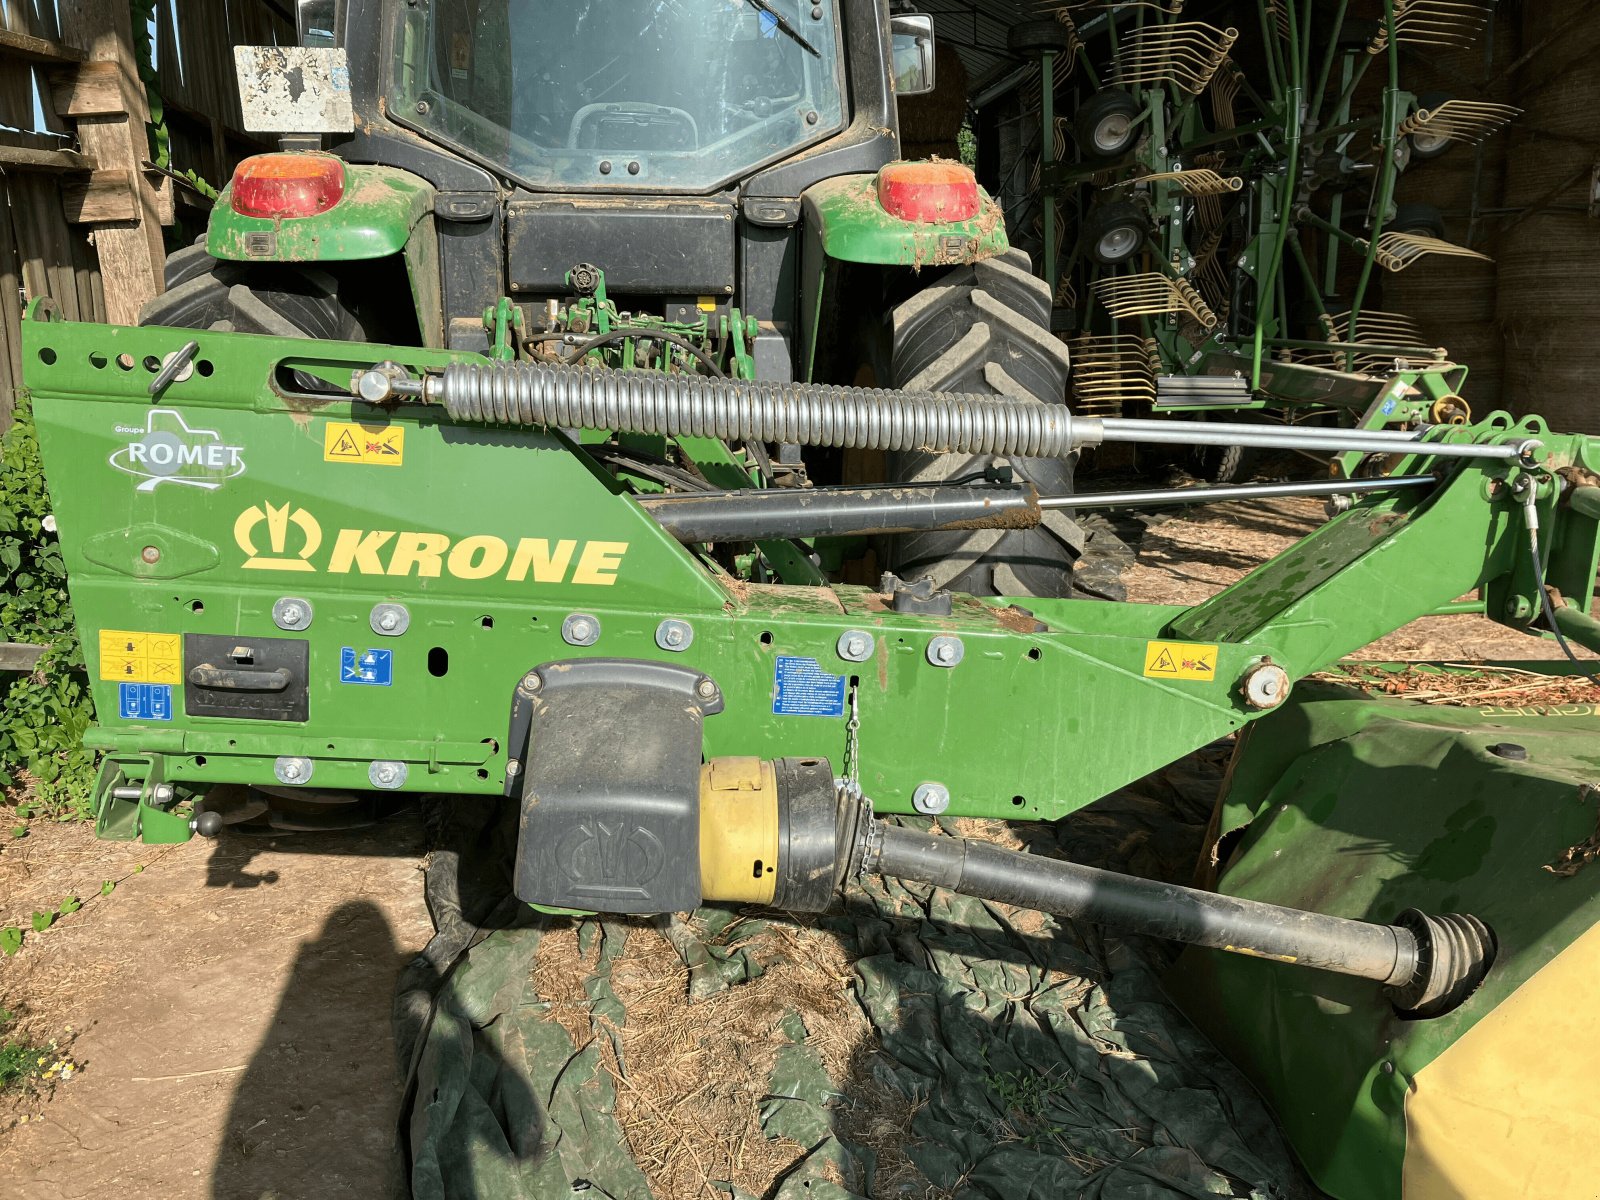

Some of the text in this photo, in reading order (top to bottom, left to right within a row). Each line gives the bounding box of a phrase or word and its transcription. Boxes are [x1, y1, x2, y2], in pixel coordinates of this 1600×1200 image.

[115, 425, 145, 435] Groupe
[128, 442, 244, 466] ROMET
[327, 528, 630, 586] KRONE
